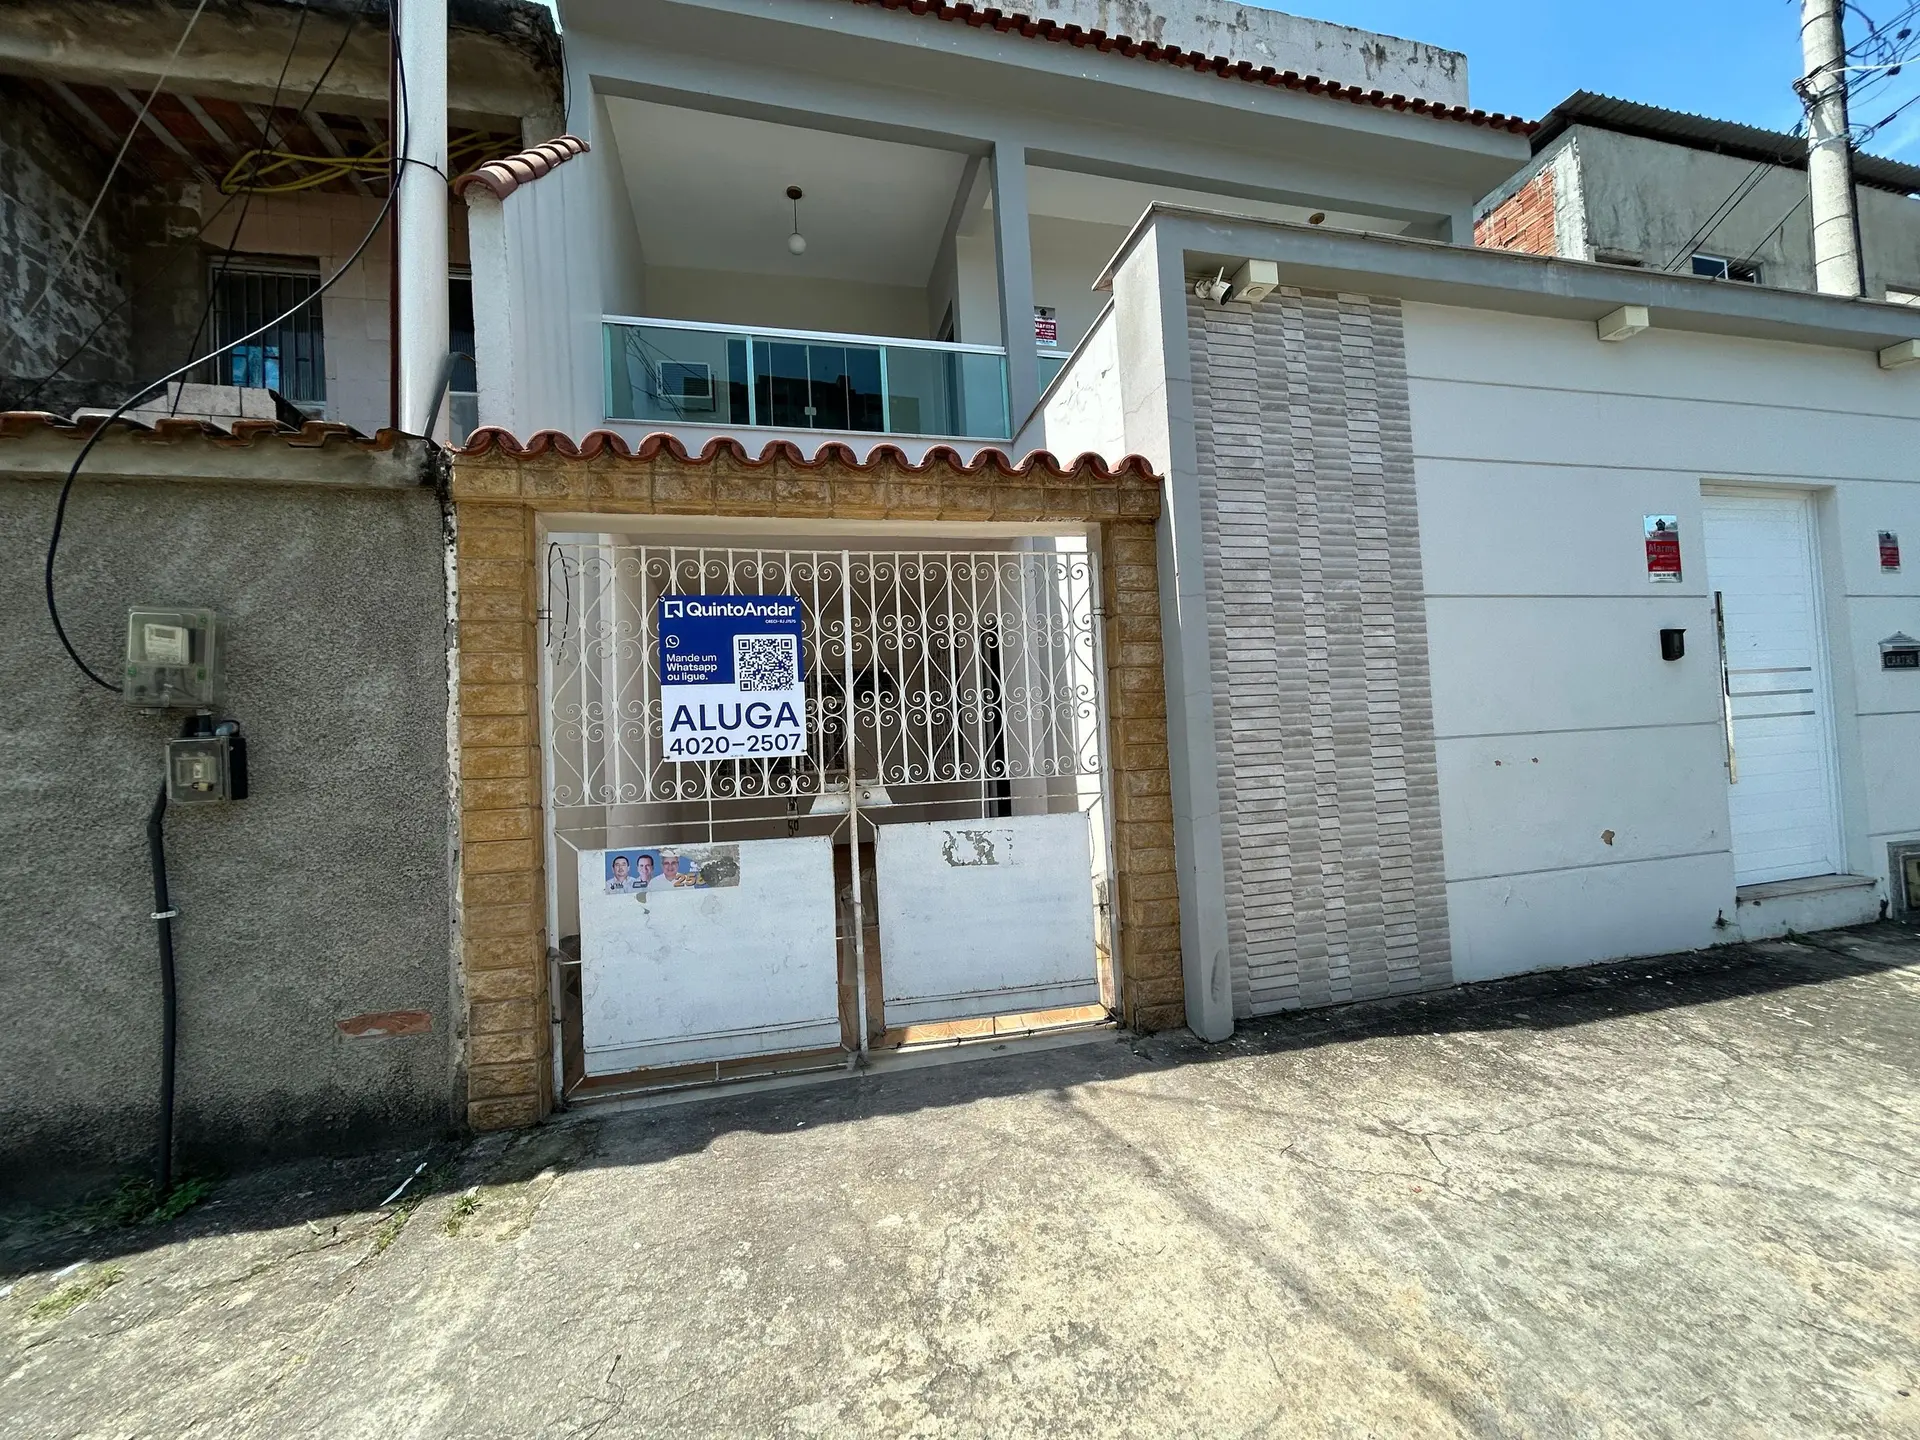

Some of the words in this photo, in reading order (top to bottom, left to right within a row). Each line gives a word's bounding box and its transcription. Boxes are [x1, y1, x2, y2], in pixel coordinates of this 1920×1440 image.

[1648, 543, 1677, 553] Alarme
[686, 602, 796, 617] QuintoAndar
[666, 653, 700, 662] Mande
[667, 663, 718, 673] Whatsapp
[681, 672, 709, 683] ligue.
[669, 702, 800, 732] ALUGA
[669, 733, 801, 756] 4020-2507
